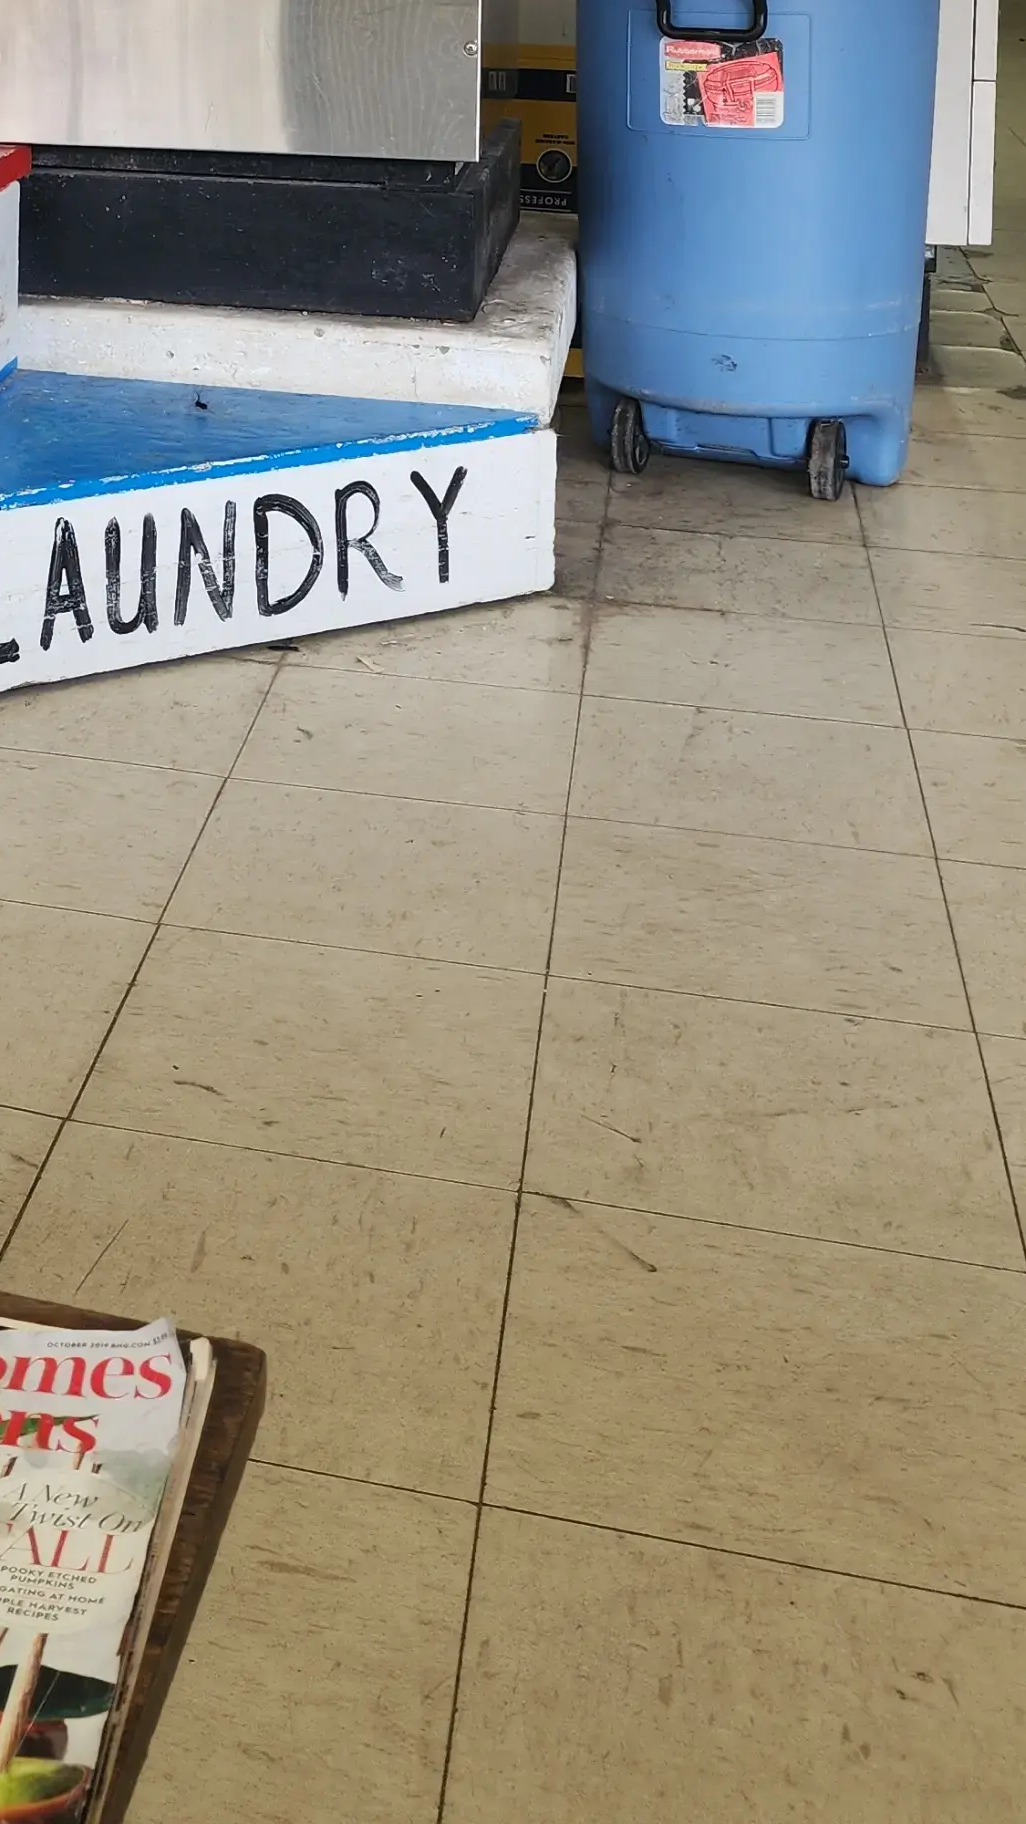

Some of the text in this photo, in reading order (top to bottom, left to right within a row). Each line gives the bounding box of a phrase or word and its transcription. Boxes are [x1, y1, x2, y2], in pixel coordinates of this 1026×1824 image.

[46, 1340, 87, 1348] OCTOBER
[3, 1482, 99, 1508] A New
[9, 1501, 144, 1534] Twist On
[10, 1574, 75, 1590] PUMPKINS
[47, 1570, 97, 1584] ETCHED
[50, 1591, 66, 1601] AT
[68, 1595, 107, 1605] HOME
[6, 1607, 60, 1622] RECIPES
[28, 1602, 89, 1616] HARVEST
